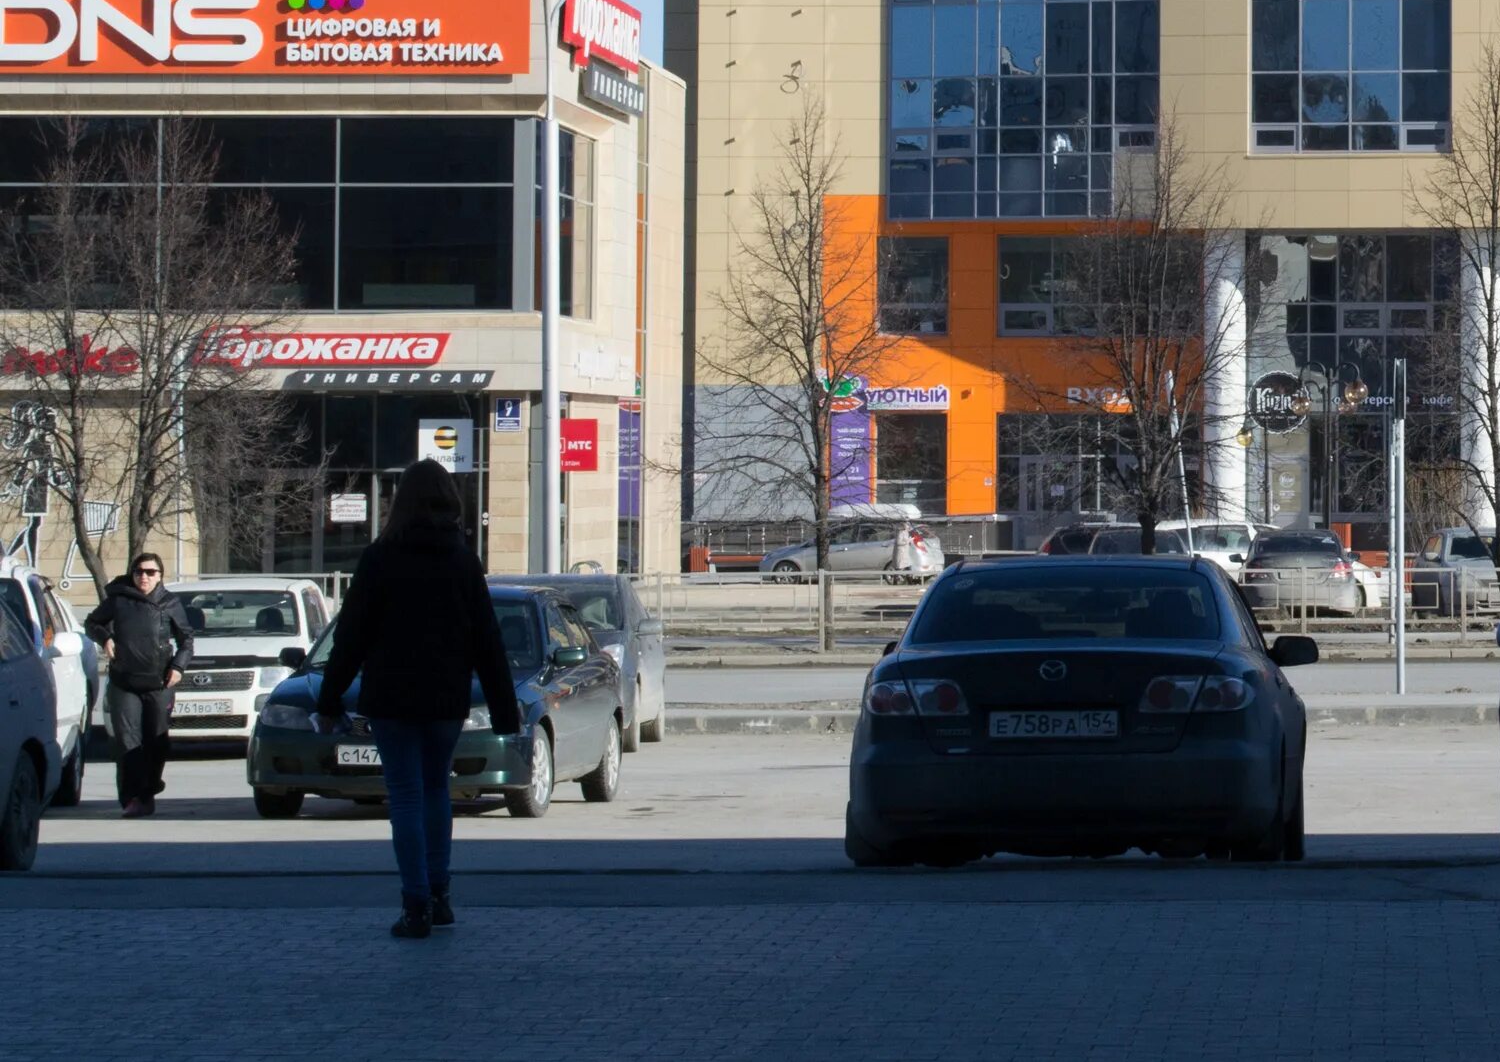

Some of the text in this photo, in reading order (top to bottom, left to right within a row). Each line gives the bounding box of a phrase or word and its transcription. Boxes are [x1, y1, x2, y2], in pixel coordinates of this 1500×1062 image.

[286, 17, 440, 40] ЦИФРОВАЯ И
[286, 43, 504, 63] БЫТОВАЯ ТЕХНИКА
[593, 70, 645, 113] УНИВЕРСАМ
[203, 328, 439, 367] Горожанка
[303, 372, 488, 385] УНИВЕРСАМ
[866, 385, 948, 403] УЮТНЫЙ
[567, 440, 593, 451] МТС
[996, 712, 1113, 735] Е758РА 154
